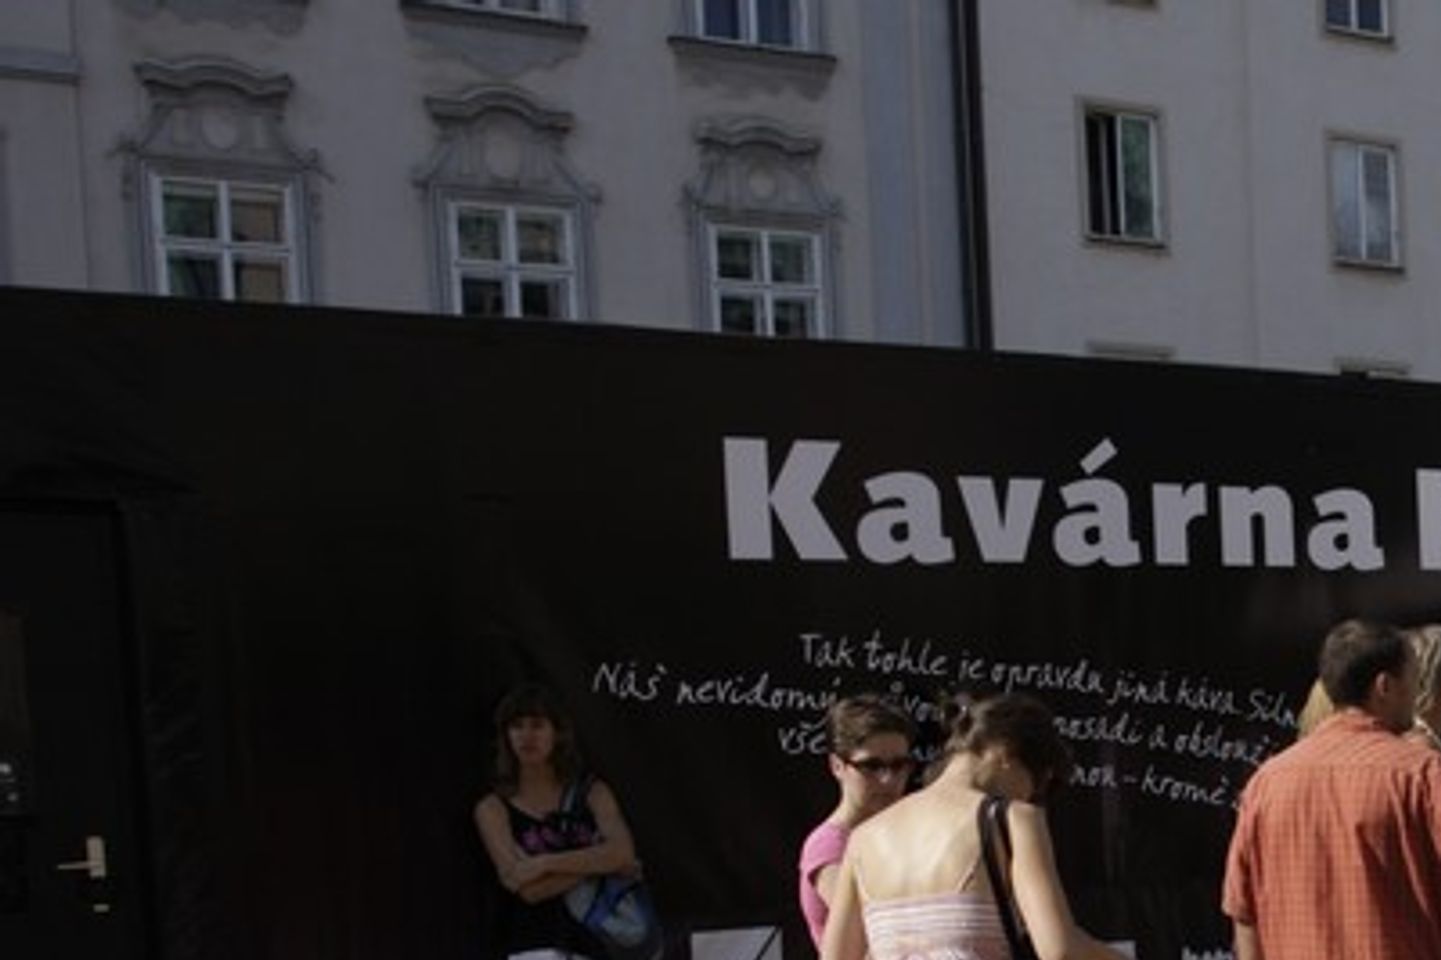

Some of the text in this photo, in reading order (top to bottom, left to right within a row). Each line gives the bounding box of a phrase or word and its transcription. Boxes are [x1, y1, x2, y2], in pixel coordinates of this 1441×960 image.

[723, 436, 1383, 572] Kavárna
[592, 661, 668, 701] Náš
[800, 633, 856, 669] Tak
[863, 629, 949, 676] tohle
[957, 651, 984, 681] je
[990, 658, 1104, 692] opravdu
